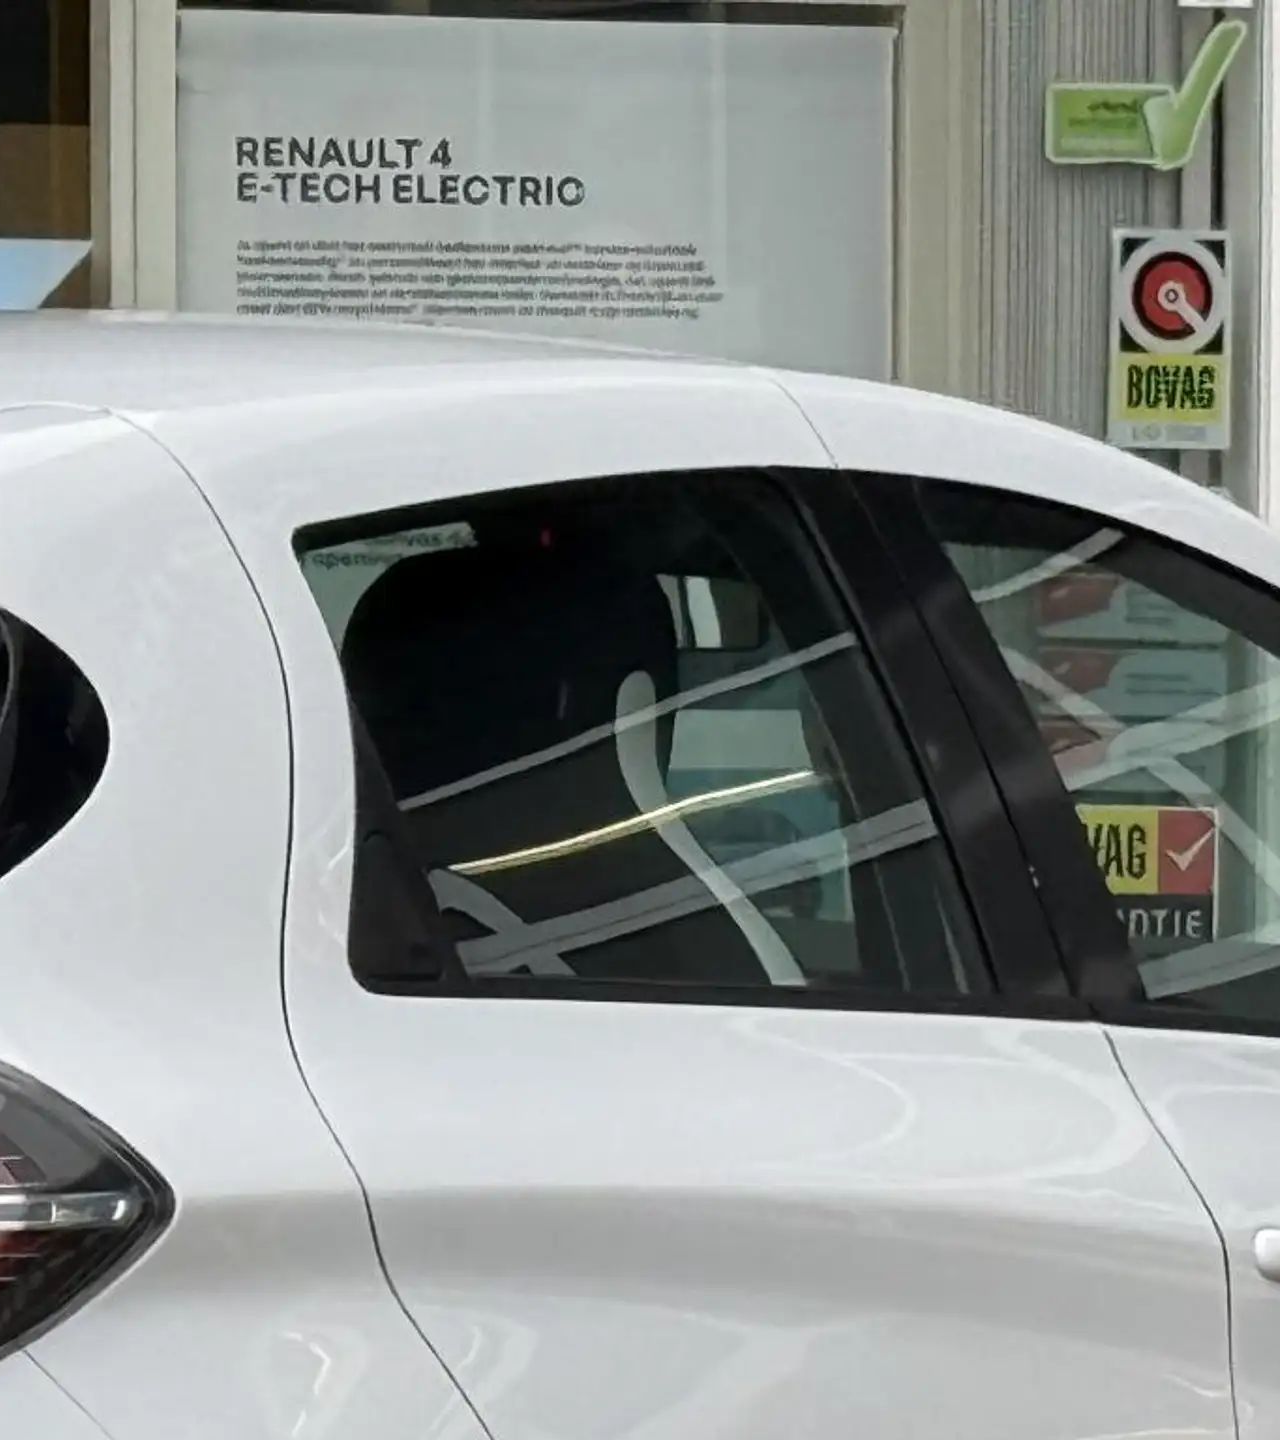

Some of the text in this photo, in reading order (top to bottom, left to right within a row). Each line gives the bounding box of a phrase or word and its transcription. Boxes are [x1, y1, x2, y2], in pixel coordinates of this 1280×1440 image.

[235, 136, 452, 169] RENAULT 4
[236, 172, 586, 206] E-TECH ELECTRIC
[1127, 364, 1216, 409] BOVAG
